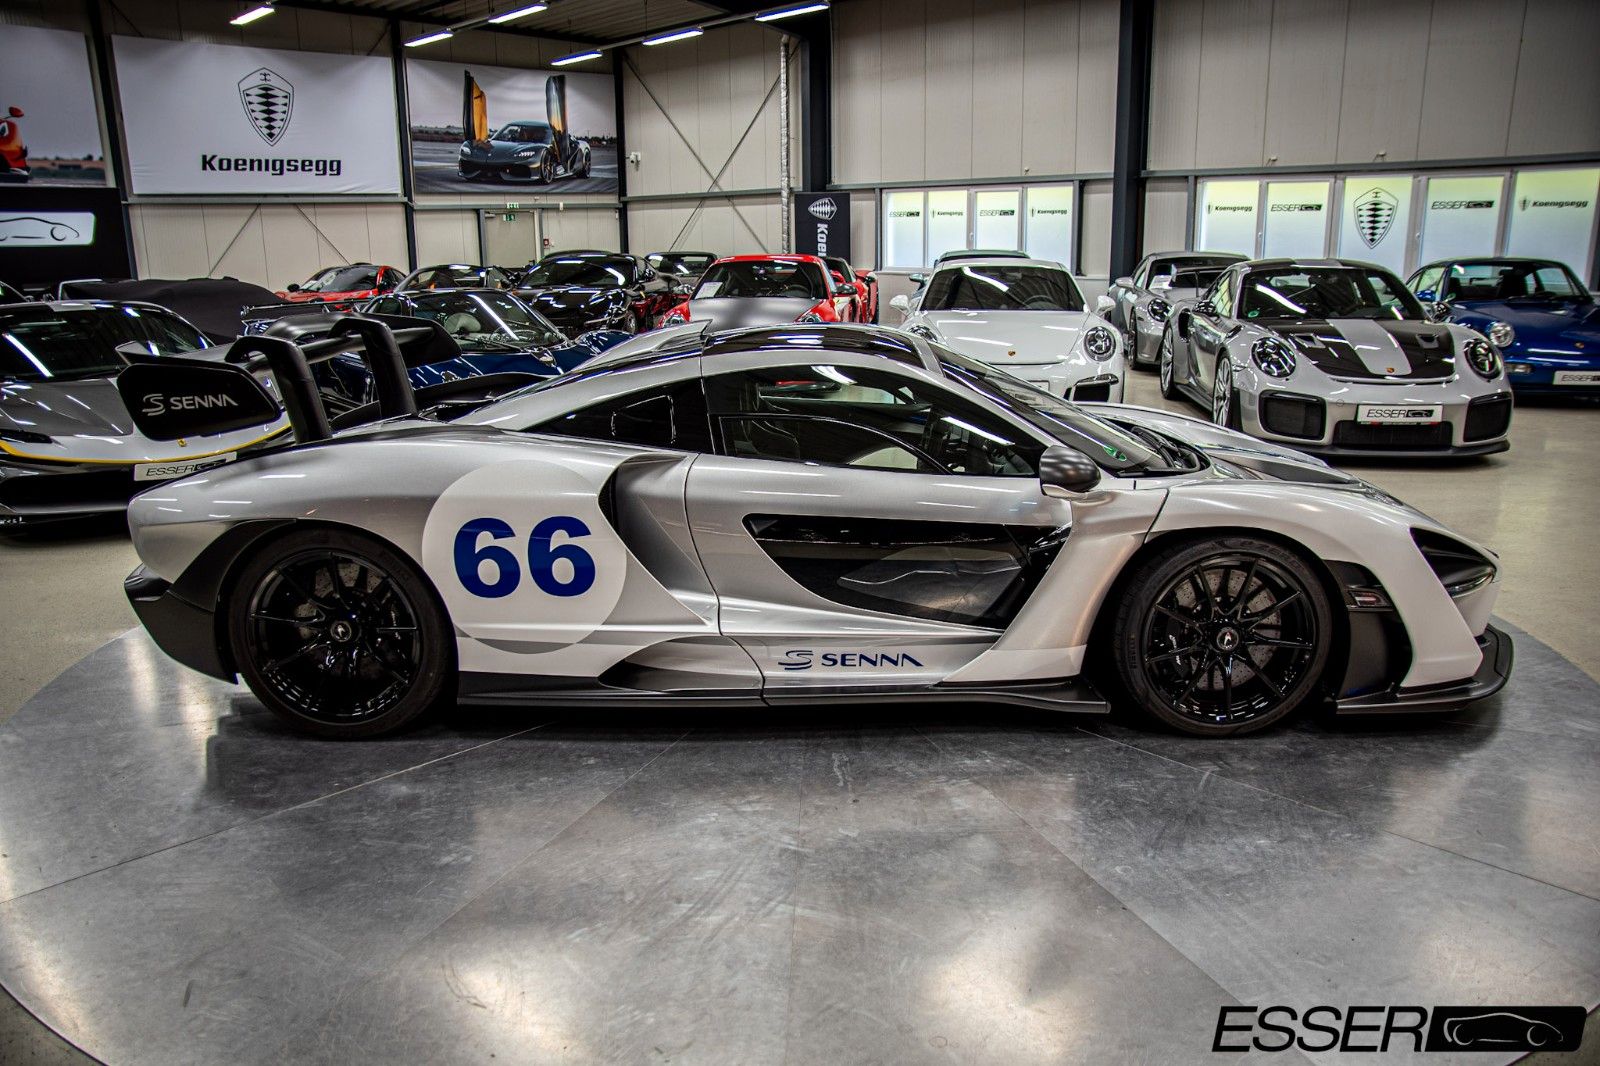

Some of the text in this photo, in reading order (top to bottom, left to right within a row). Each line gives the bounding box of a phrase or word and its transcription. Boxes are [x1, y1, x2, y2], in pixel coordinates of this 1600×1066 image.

[201, 154, 342, 176] Koenigsegg
[1271, 204, 1300, 212] ESSER
[1431, 201, 1467, 210] ESSER
[1532, 200, 1589, 209] Koenigsegg
[170, 393, 239, 410] SENNA
[1366, 409, 1406, 418] ESSER
[146, 465, 195, 477] ESSER
[453, 516, 596, 598] 66
[821, 653, 924, 667] SENNA
